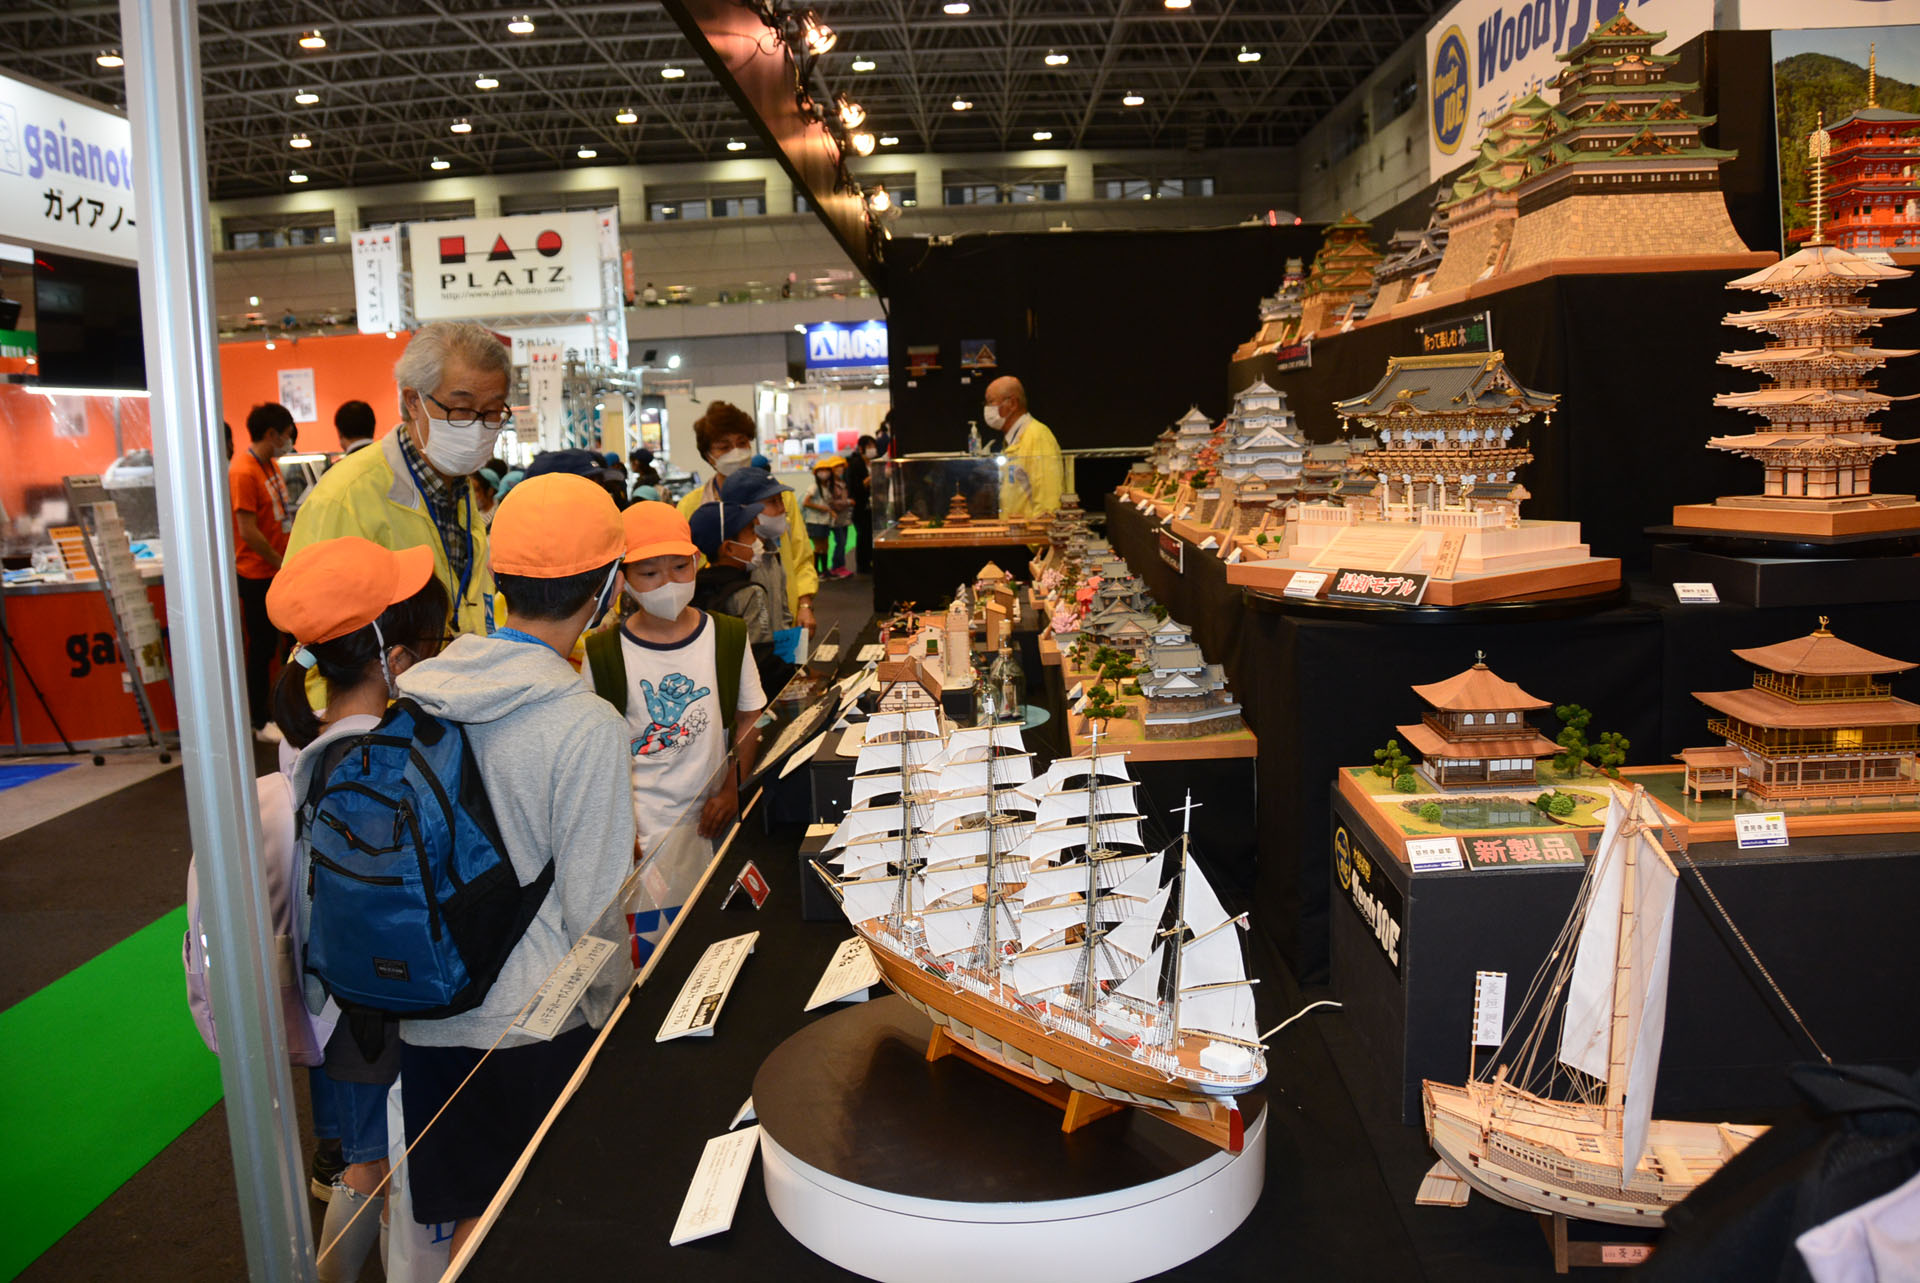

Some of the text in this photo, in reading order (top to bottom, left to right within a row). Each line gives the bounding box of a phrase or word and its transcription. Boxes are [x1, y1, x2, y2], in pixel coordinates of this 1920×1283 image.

[1441, 84, 1466, 135] JOE
[24, 118, 134, 190] gaianot
[440, 266, 567, 290] PLATZ
[1337, 572, 1417, 598] 最新モデル
[1472, 837, 1575, 864] 新製品
